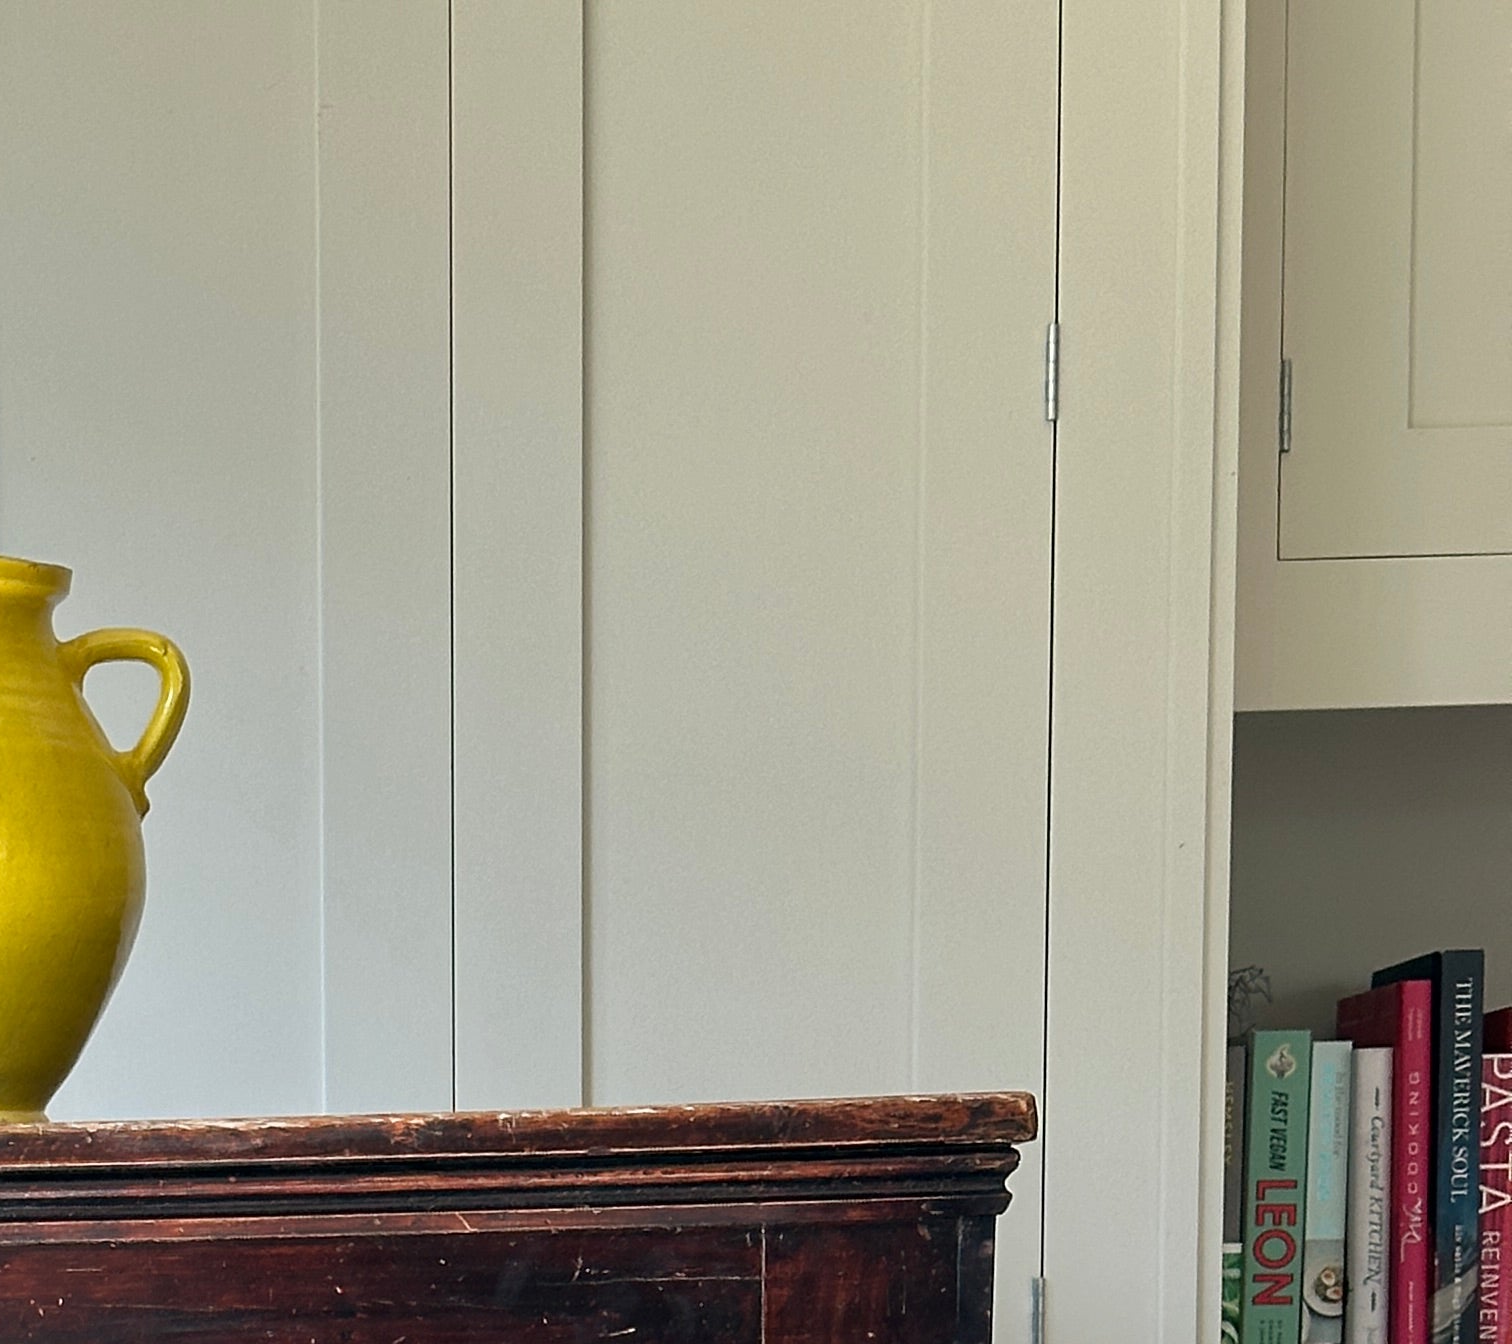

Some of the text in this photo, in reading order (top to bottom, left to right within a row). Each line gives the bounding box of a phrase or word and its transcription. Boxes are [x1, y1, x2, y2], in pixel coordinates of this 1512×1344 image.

[1268, 1091, 1290, 1172] FAST VEGAN
[1407, 1072, 1421, 1194] COOKING
[1449, 977, 1473, 1204] THE MAVERICK SOUL
[1478, 1053, 1512, 1214] PASTA
[1251, 1179, 1298, 1306] LEON
[1363, 1116, 1385, 1287] Courtyard KITCHEN
